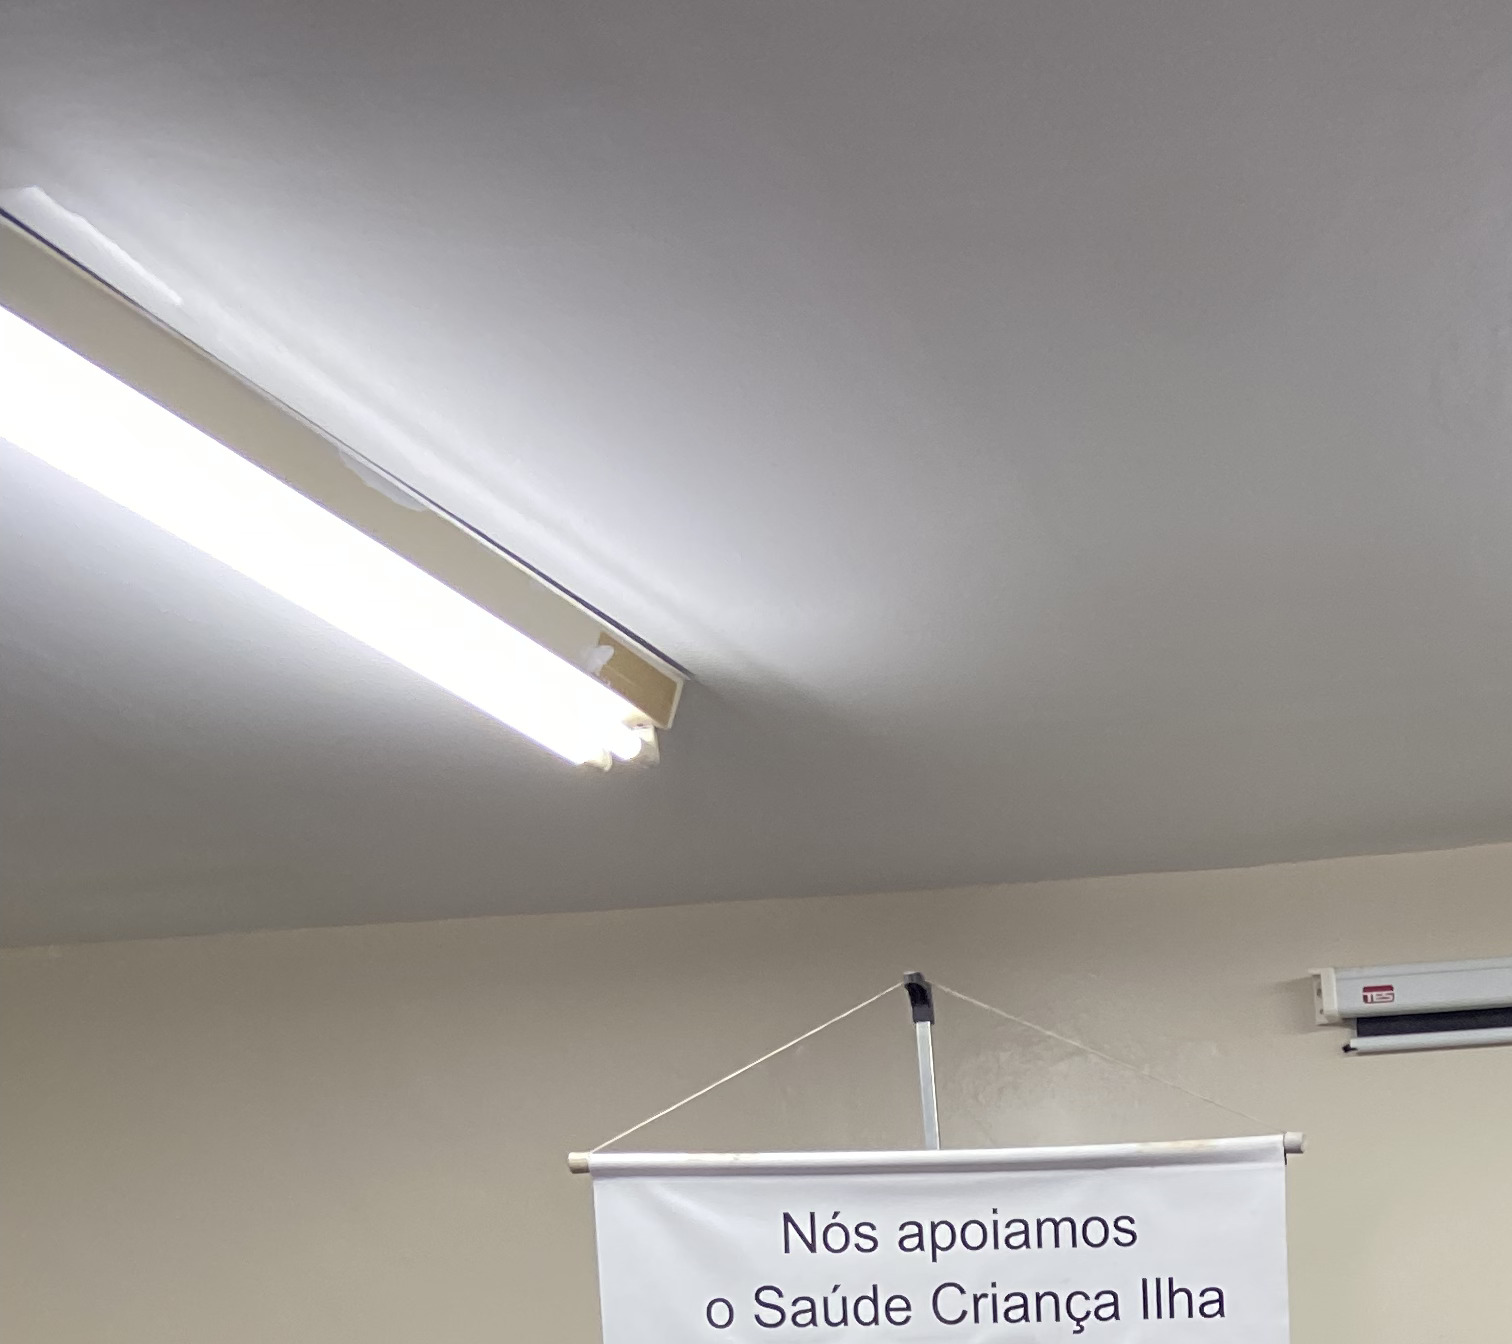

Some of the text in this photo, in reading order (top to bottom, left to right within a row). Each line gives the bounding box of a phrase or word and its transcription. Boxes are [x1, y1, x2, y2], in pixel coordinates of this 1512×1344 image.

[783, 1208, 1137, 1263] Nós apoiamos
[706, 1277, 1225, 1335] o Saúde Criança Ilha
